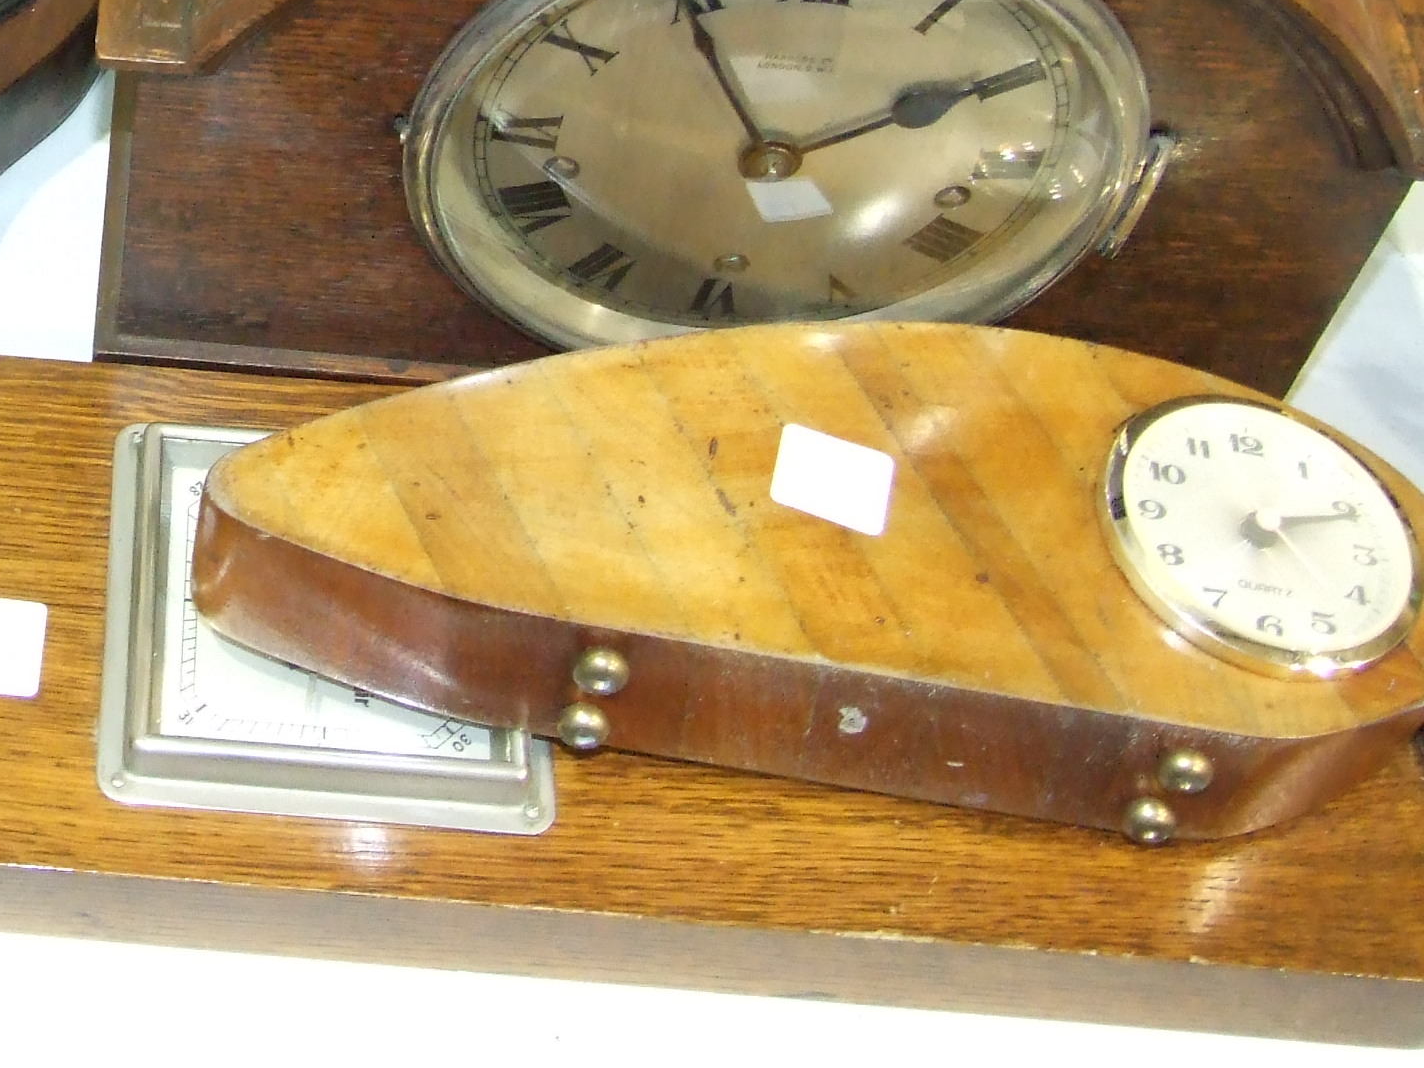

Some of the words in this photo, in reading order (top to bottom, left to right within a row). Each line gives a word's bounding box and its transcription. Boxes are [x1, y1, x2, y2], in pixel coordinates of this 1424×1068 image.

[544, 18, 619, 76] X
[688, 277, 738, 316] VI
[1186, 437, 1210, 459] 11
[1228, 433, 1265, 457] 12
[1149, 461, 1186, 485] 10
[1298, 461, 1308, 480] 1
[1138, 499, 1167, 520] 9
[1157, 543, 1185, 565] 8
[1353, 543, 1379, 566] 3
[1203, 586, 1228, 608] 7
[1237, 578, 1294, 598] QUARTZ
[1344, 584, 1371, 606] 4
[1256, 614, 1284, 637] 6
[1310, 611, 1337, 635] 5
[452, 733, 472, 752] 30
